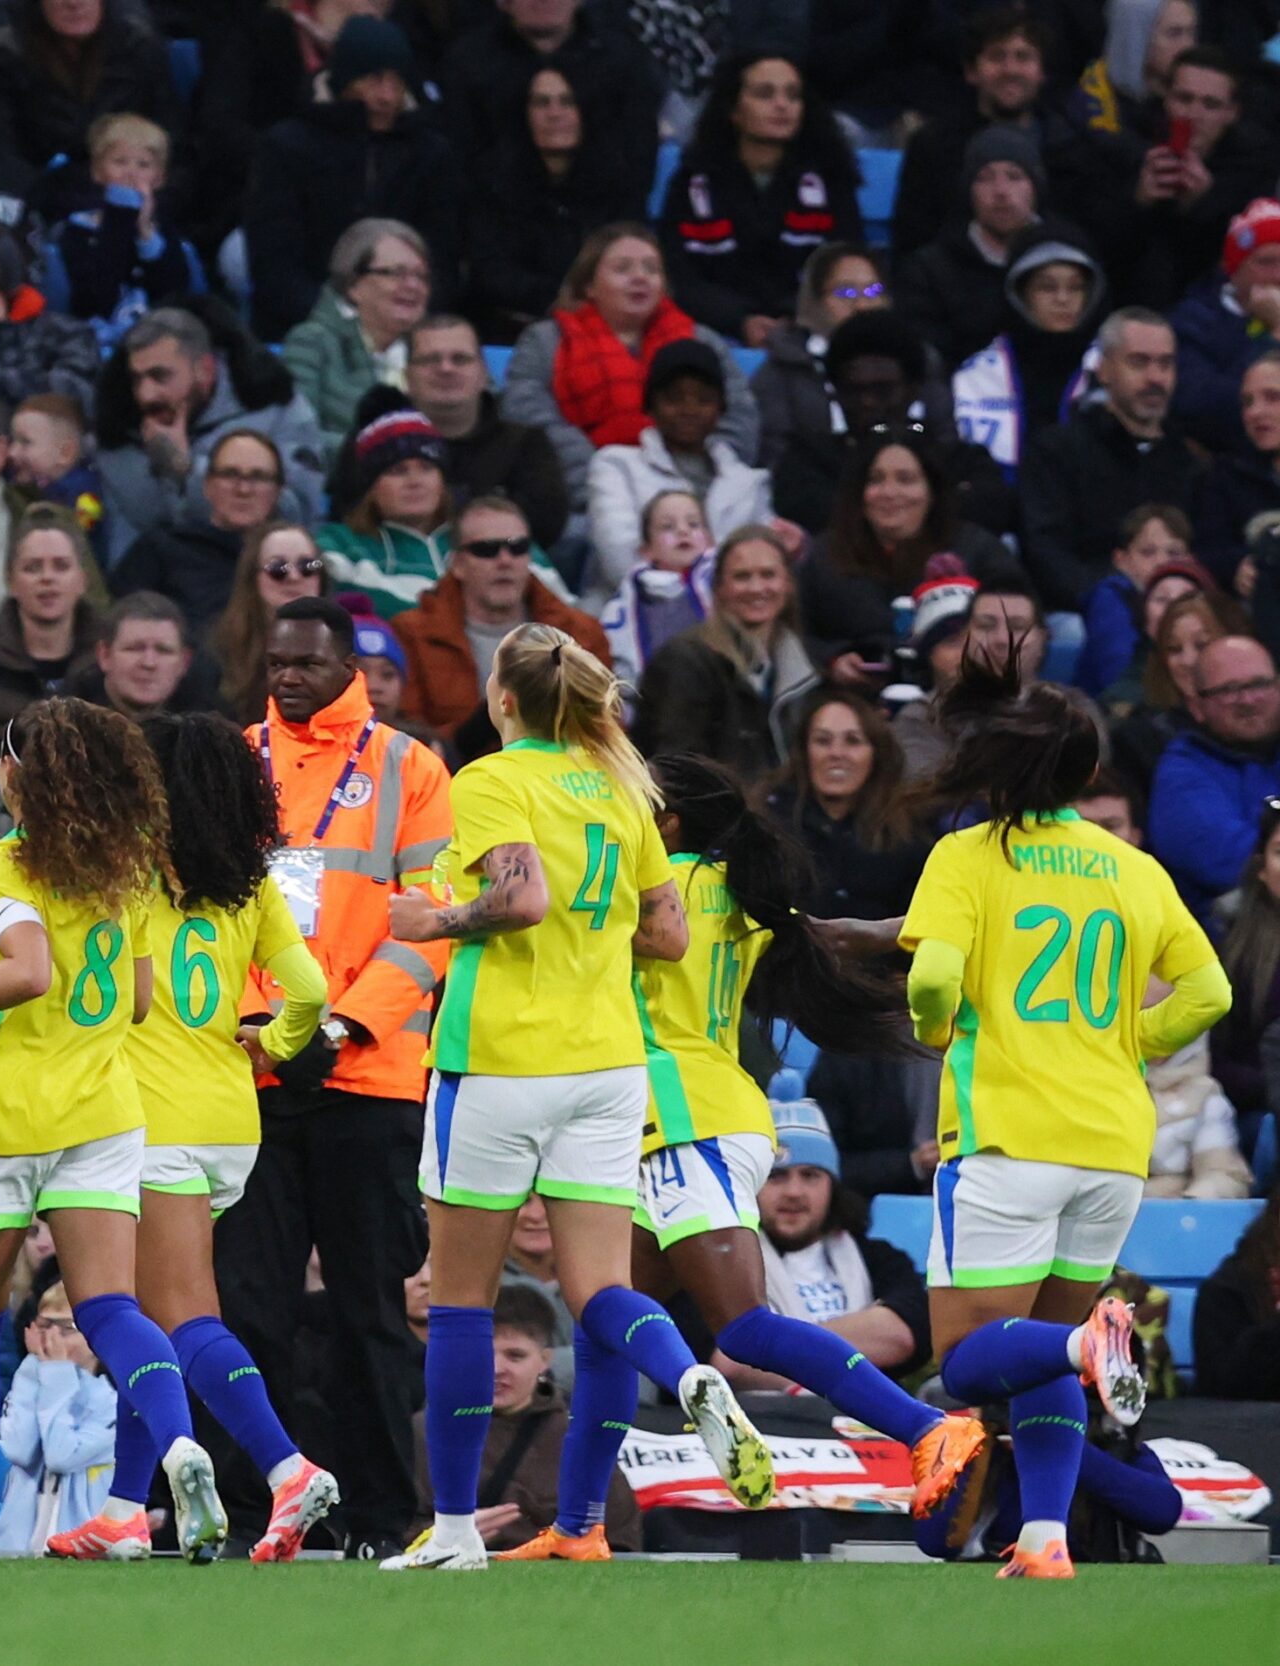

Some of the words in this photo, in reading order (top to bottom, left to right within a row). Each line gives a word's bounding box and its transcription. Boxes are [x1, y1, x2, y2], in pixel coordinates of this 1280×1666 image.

[570, 822, 620, 930] 4
[1012, 844, 1119, 883] MARIZA
[68, 918, 124, 1027] 8
[171, 916, 221, 1028] 6
[1013, 903, 1127, 1030] 20
